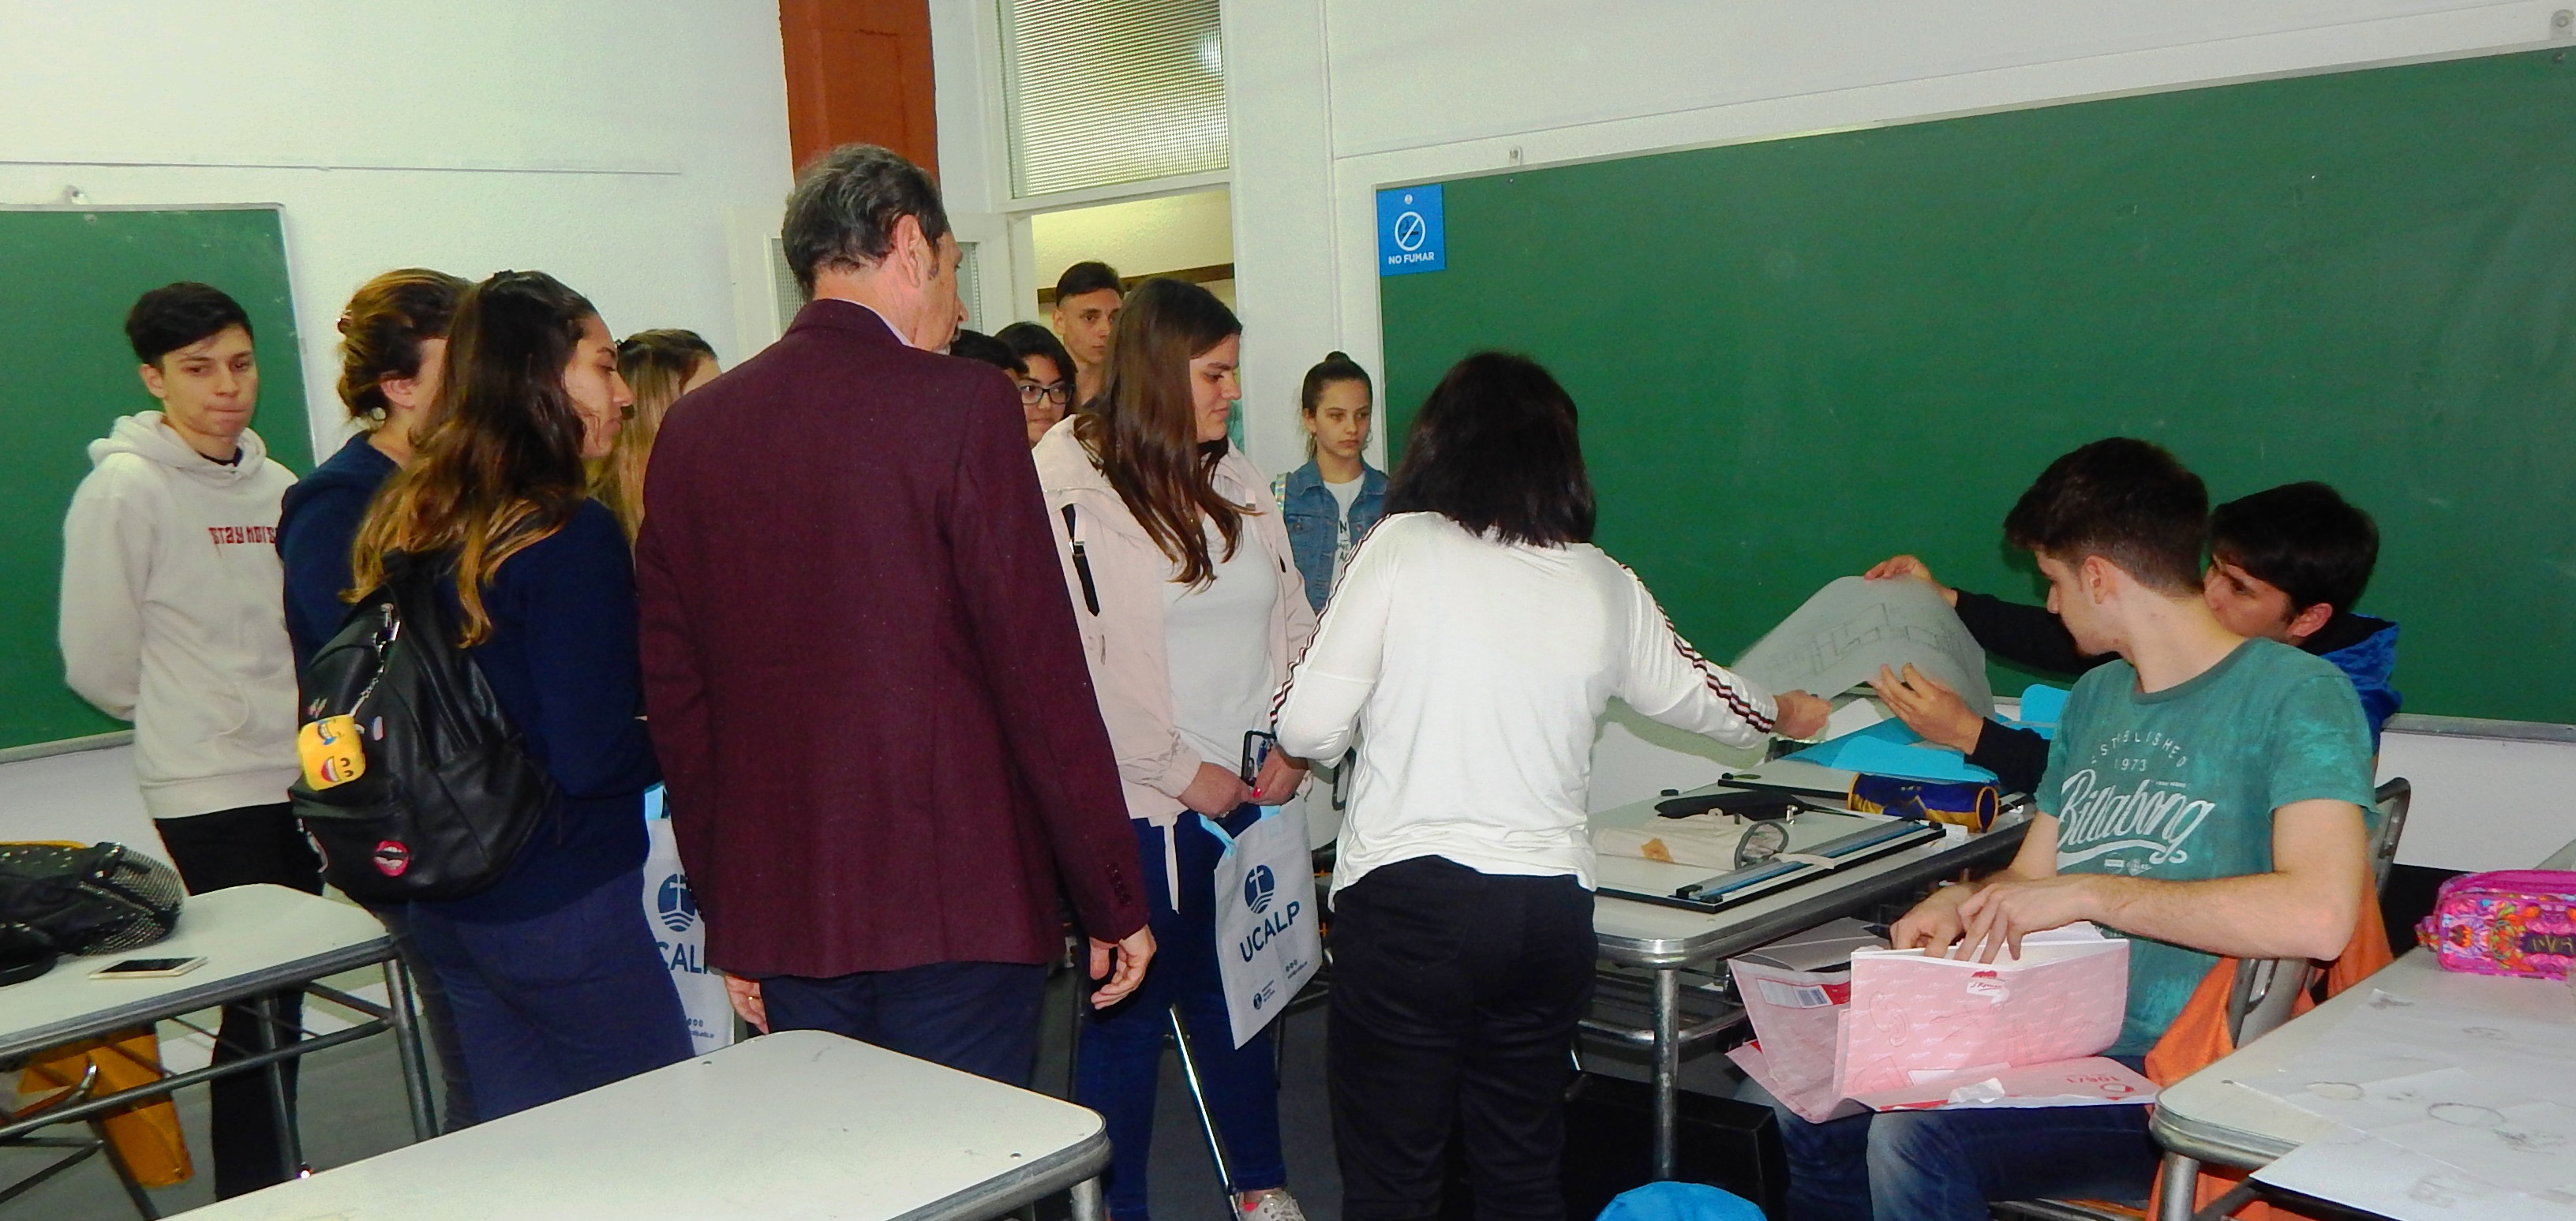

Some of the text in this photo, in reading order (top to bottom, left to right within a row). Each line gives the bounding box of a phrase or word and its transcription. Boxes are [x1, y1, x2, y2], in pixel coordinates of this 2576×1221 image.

[1388, 252, 1435, 264] NO FUMAR
[2114, 758, 2147, 772] 1973
[2057, 769, 2215, 864] Billabong
[1240, 901, 1300, 962] UCALP
